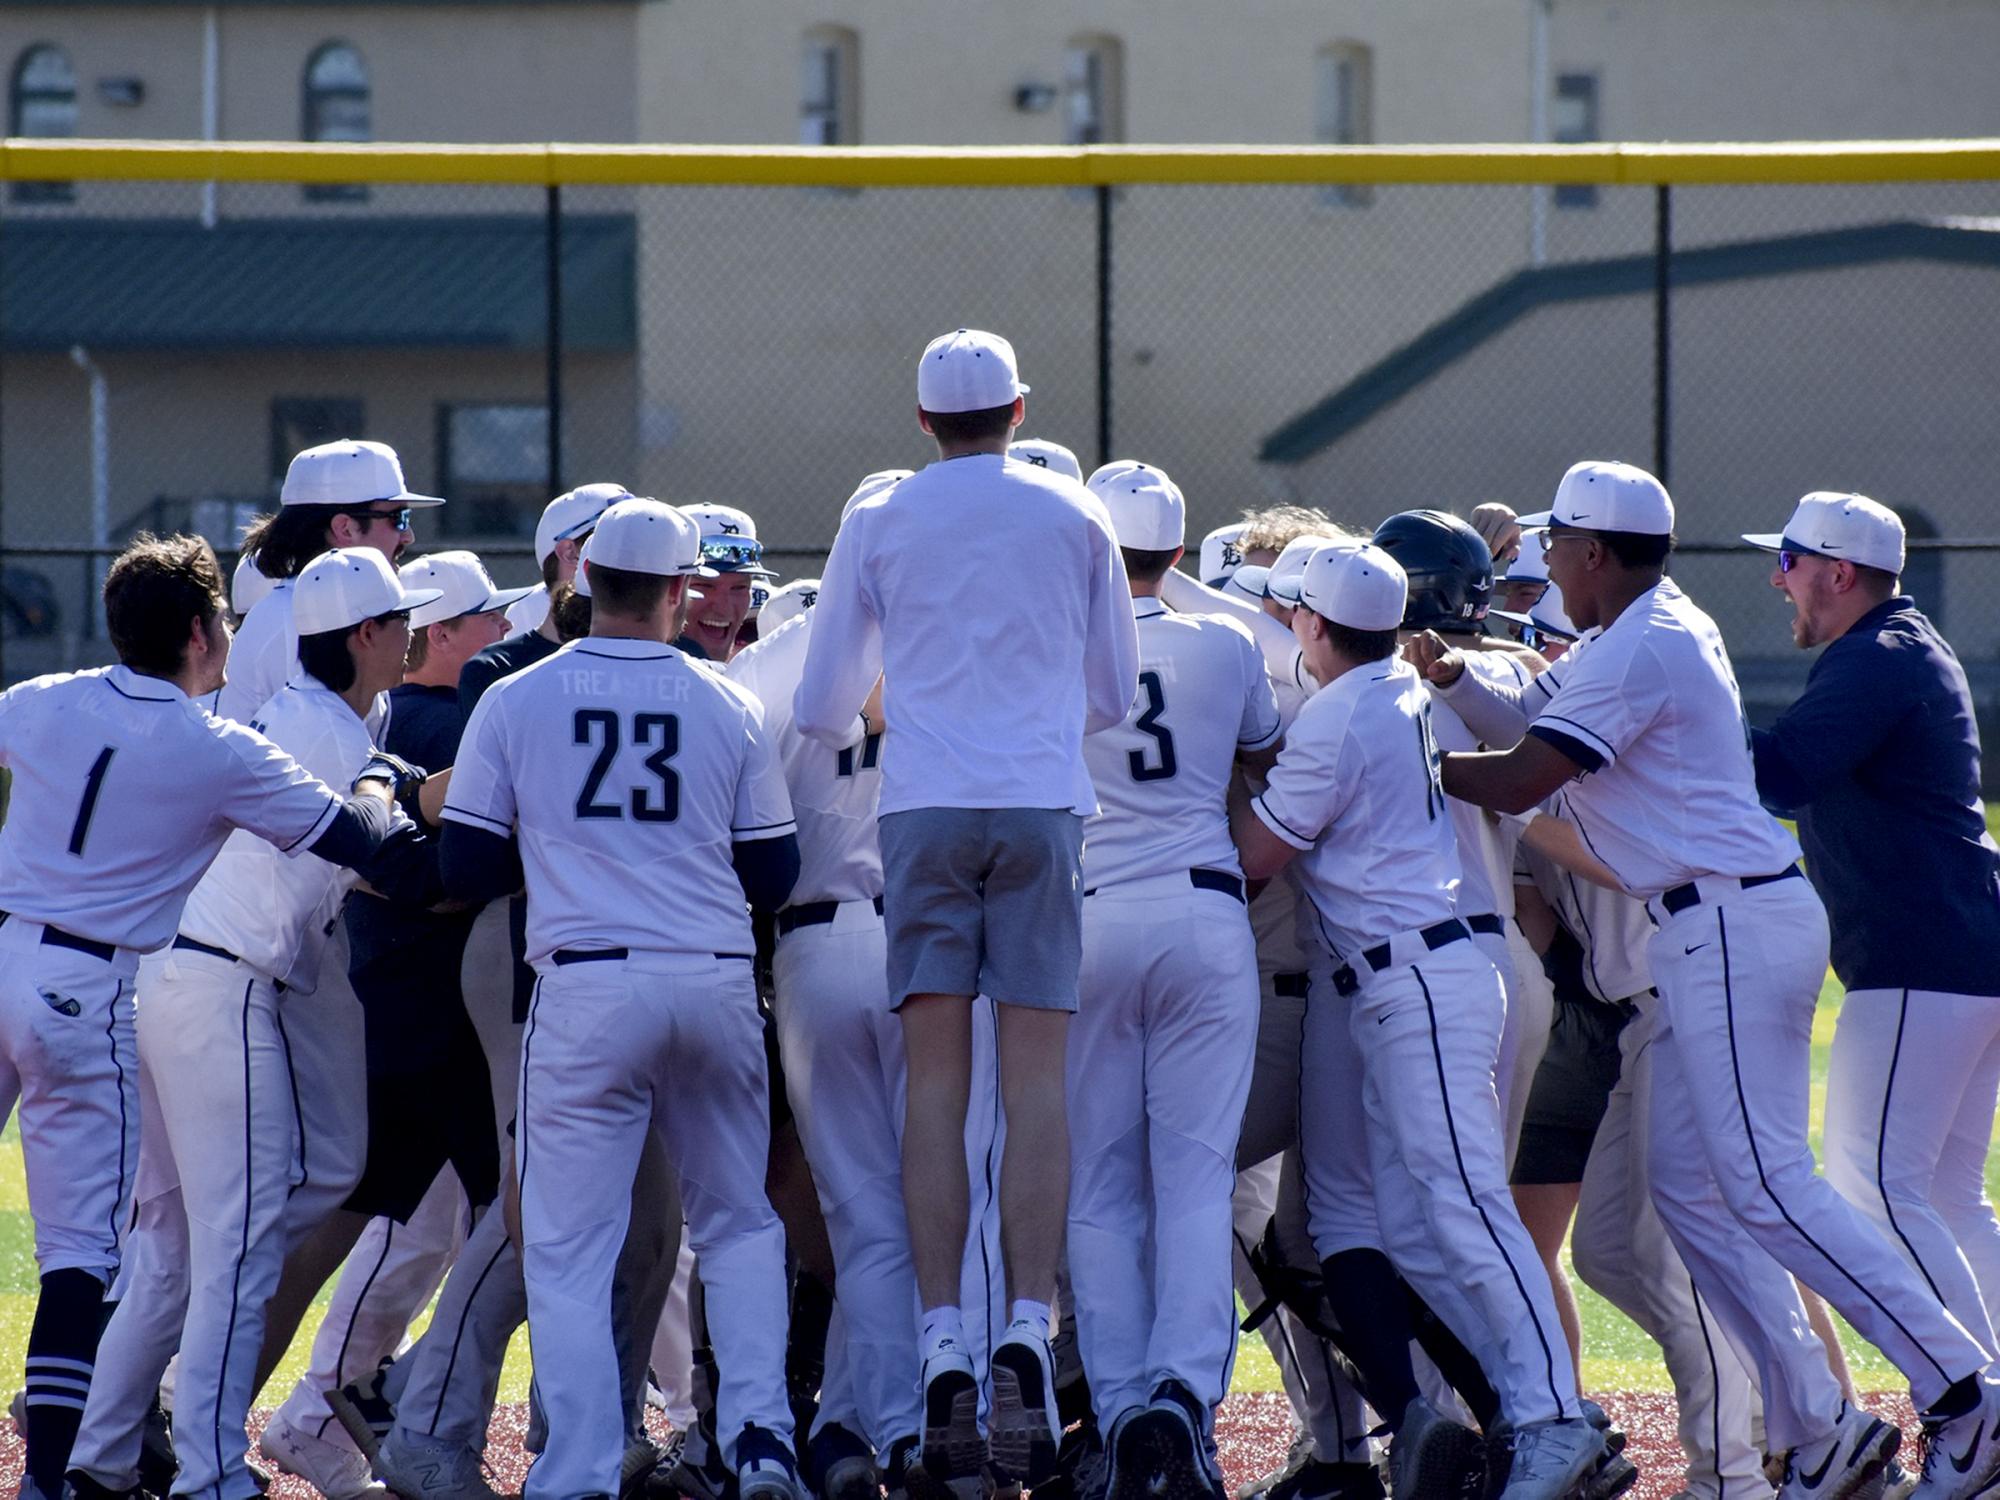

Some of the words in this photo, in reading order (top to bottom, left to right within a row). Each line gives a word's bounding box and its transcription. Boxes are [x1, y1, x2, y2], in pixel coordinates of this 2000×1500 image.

[1461, 602, 1475, 618] 18
[67, 745, 119, 856] 1
[572, 708, 682, 824] 23
